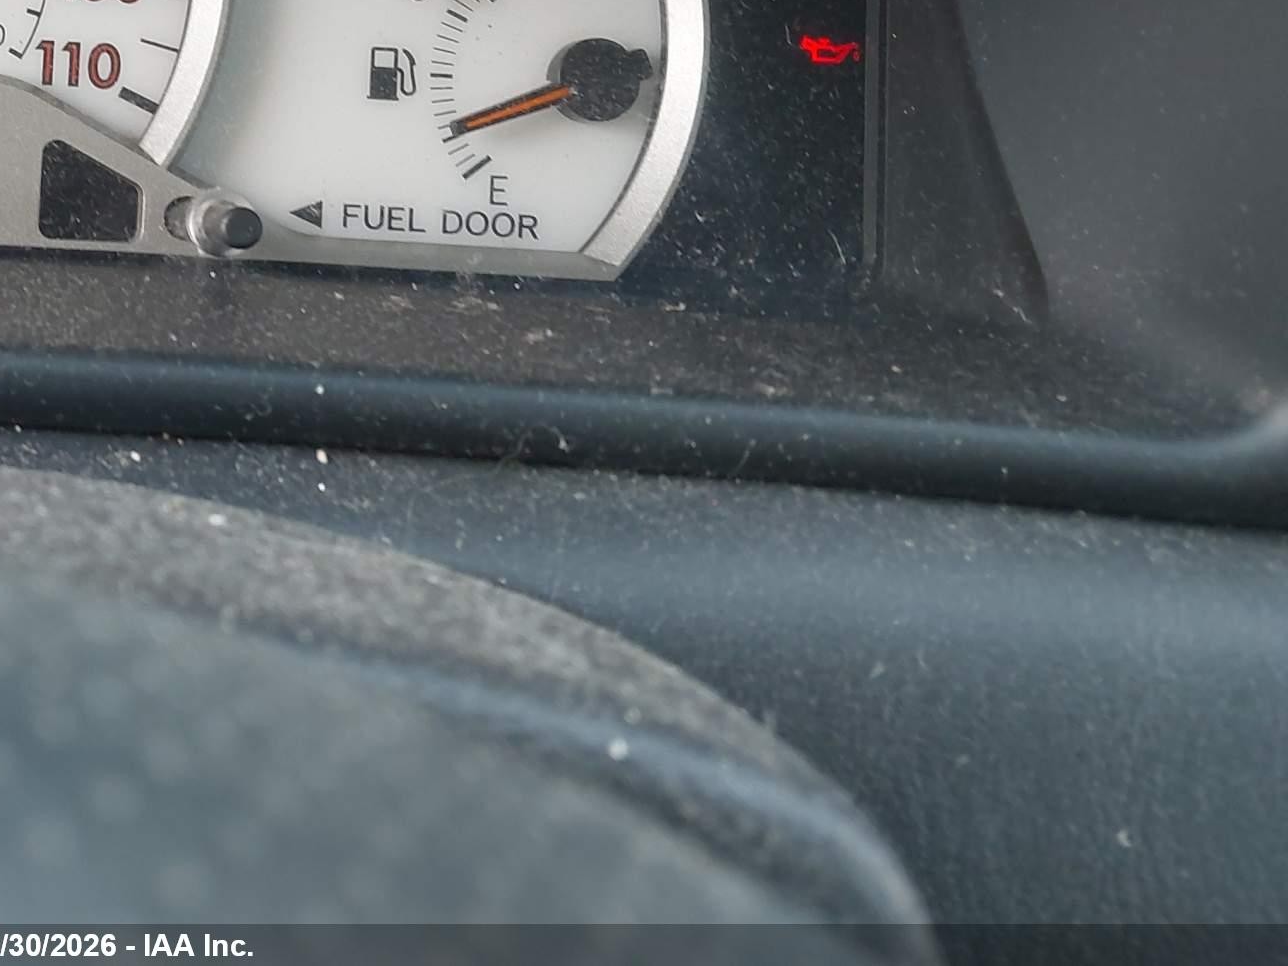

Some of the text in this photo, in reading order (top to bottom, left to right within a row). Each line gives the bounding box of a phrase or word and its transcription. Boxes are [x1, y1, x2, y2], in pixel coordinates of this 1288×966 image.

[37, 40, 121, 90] 110
[489, 175, 508, 206] E
[343, 203, 539, 240] FUEL DOOR
